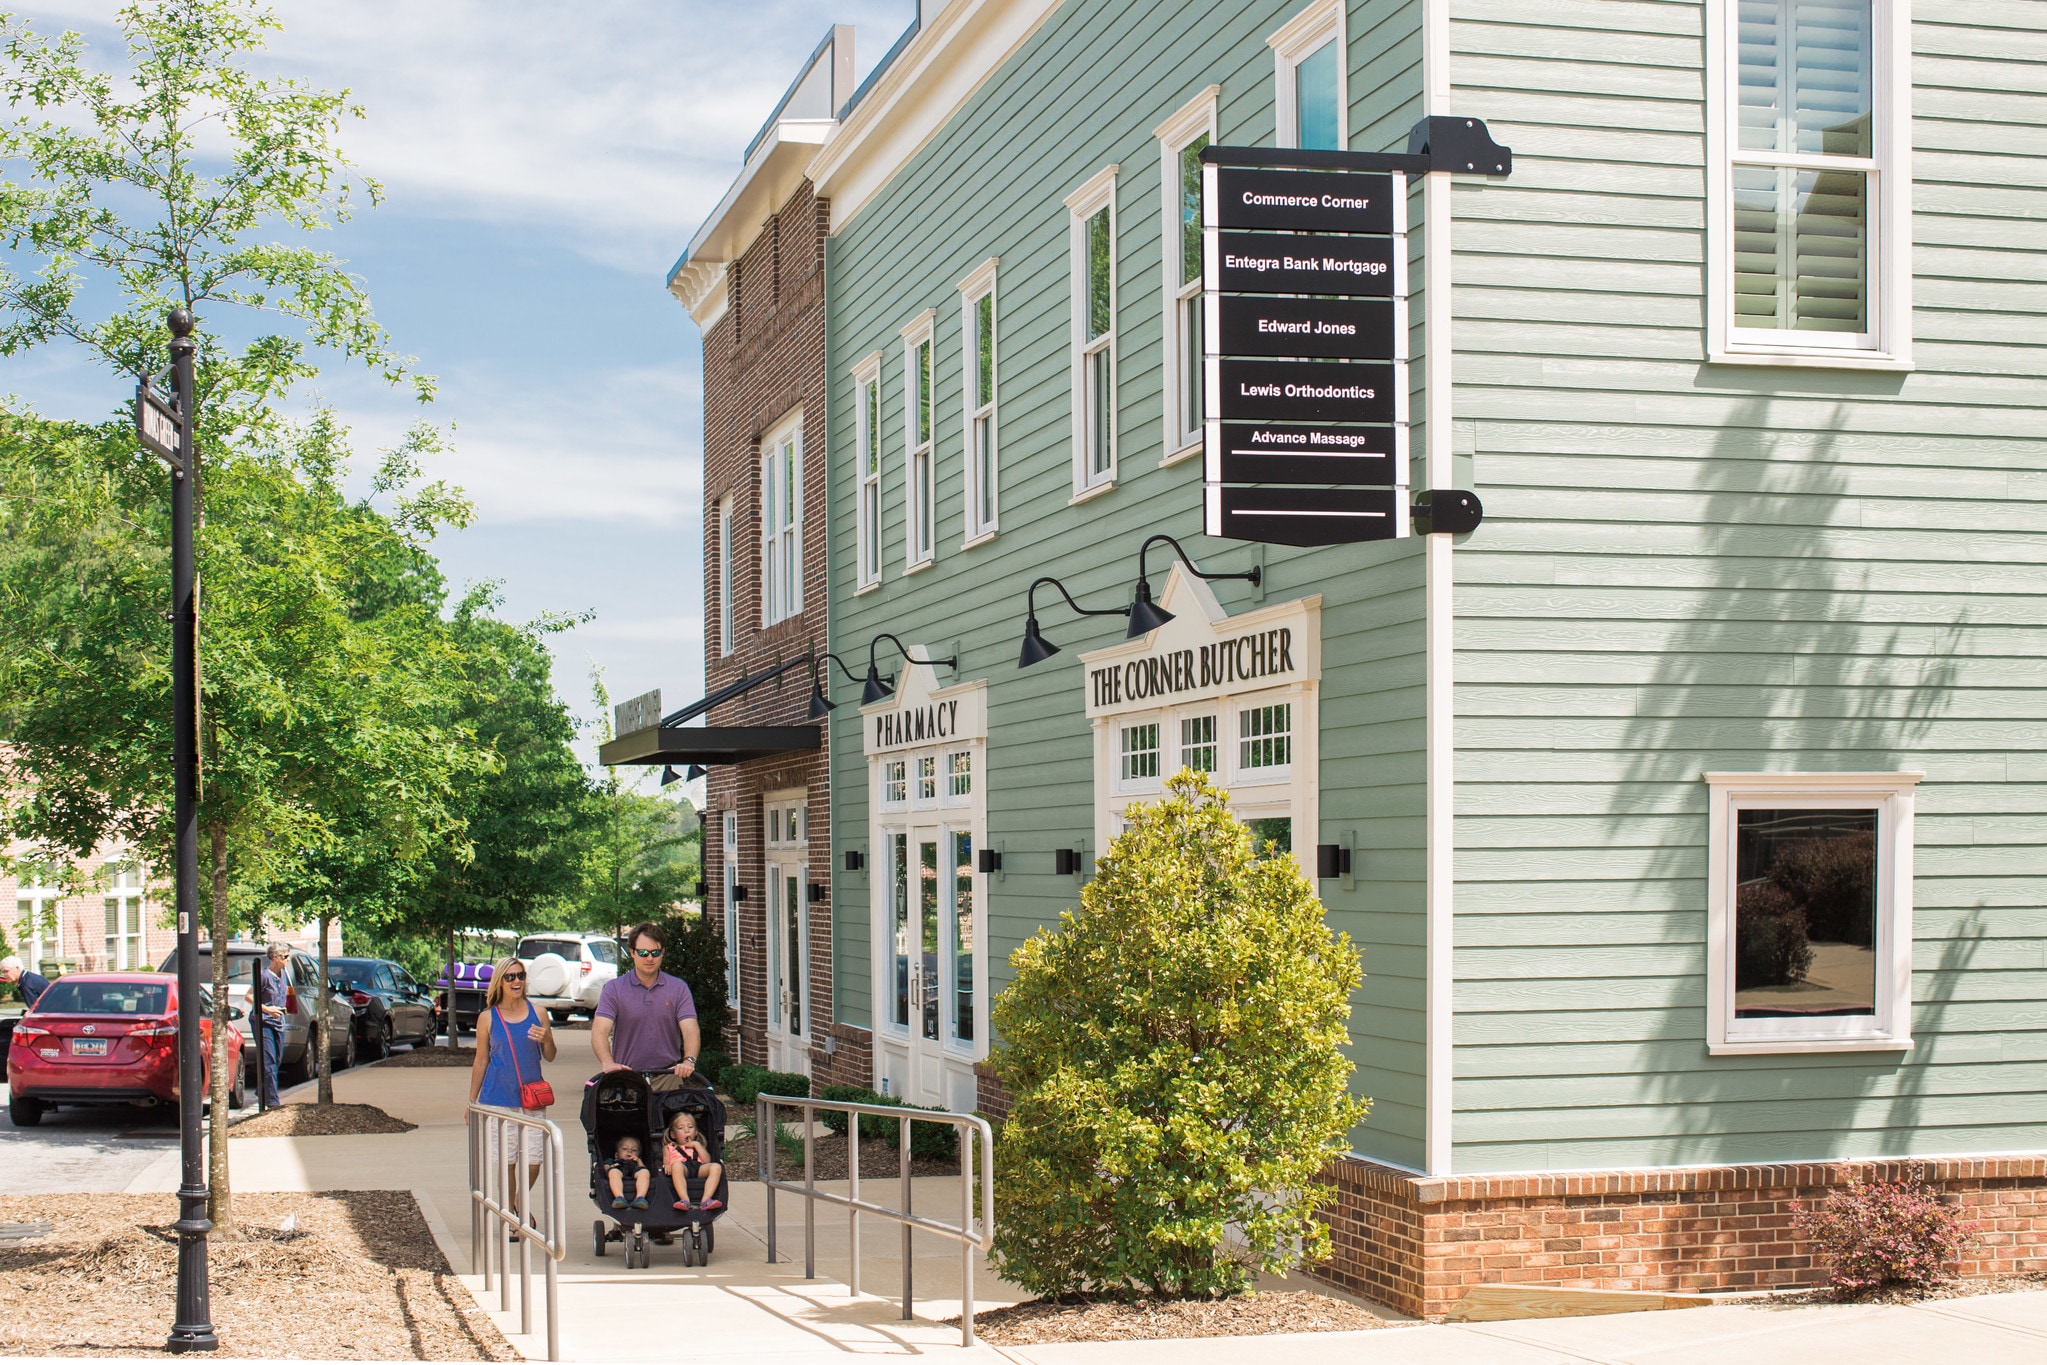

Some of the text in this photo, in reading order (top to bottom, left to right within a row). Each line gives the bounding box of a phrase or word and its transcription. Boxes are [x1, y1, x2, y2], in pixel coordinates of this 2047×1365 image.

[1243, 191, 1370, 209] Commerce Corner
[1225, 254, 1388, 276] Entegra Bank Mortgage
[1258, 319, 1357, 335] Edward Jones
[1240, 382, 1375, 399] Lewis Orthodontics
[1251, 430, 1366, 448] Advance Massage
[1090, 627, 1295, 707] THE CORNER BUTCHER
[876, 700, 958, 748] PHARMACY
